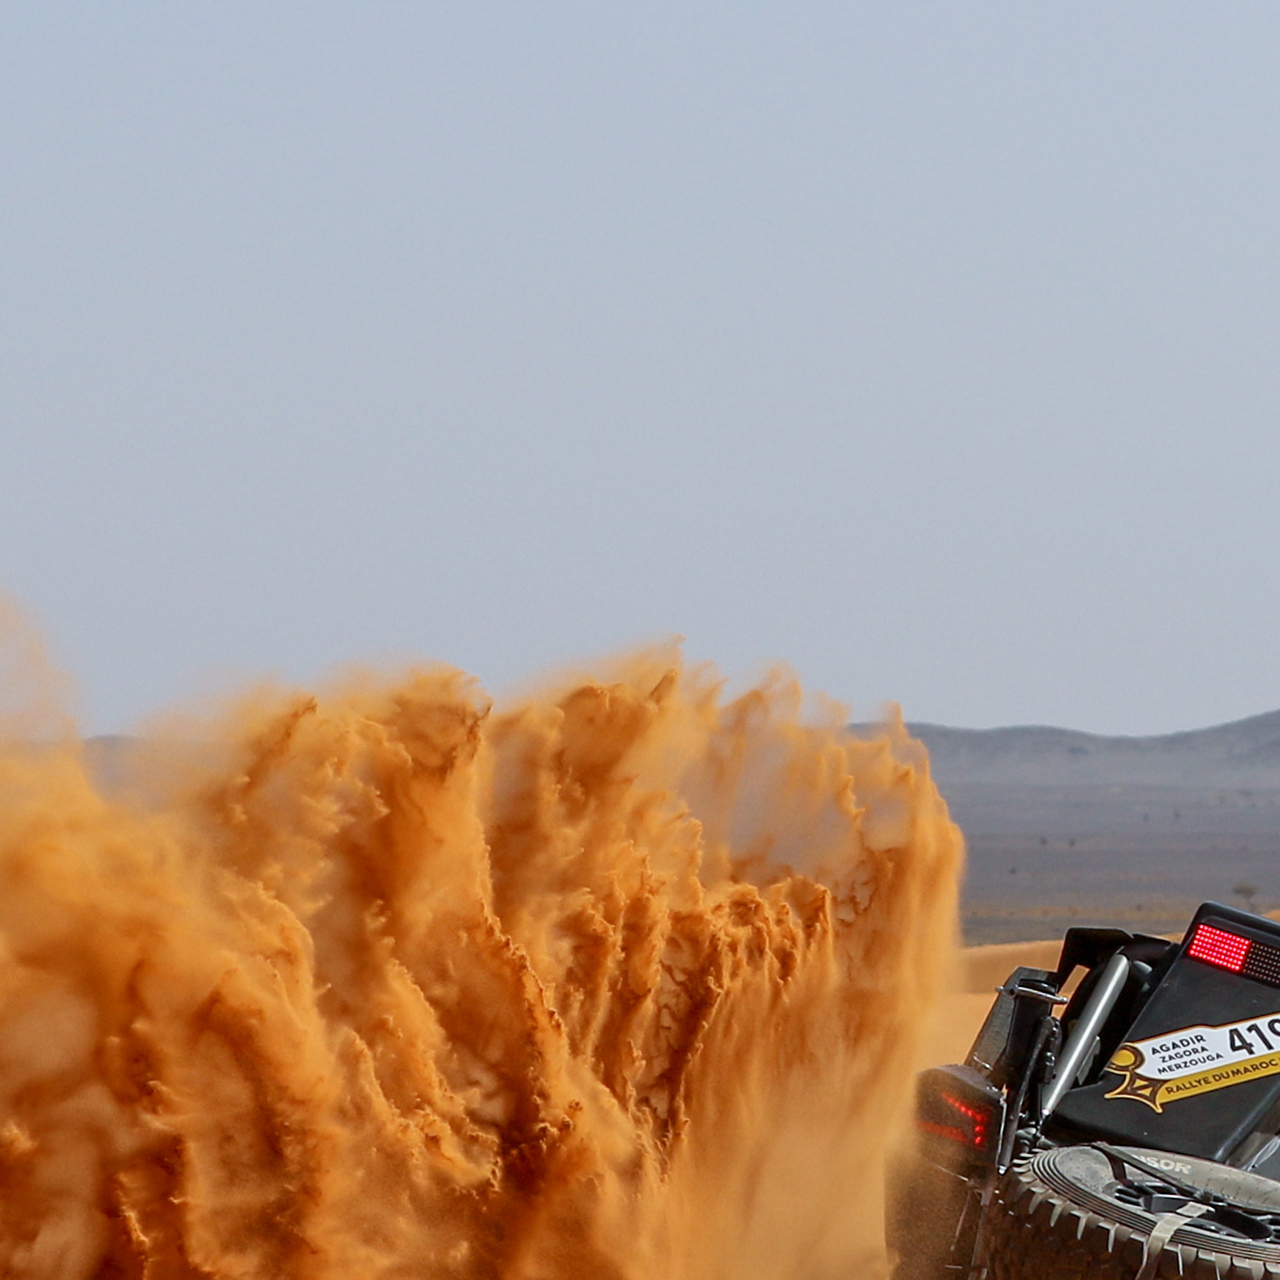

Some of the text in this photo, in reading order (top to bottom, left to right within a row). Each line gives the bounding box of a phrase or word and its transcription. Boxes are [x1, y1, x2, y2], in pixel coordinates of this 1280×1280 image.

[1151, 1034, 1207, 1055] AGADIR
[1157, 1053, 1224, 1075] MERZOUGA
[1159, 1046, 1209, 1064] ZAGORA
[1165, 1076, 1212, 1095] RALLYE
